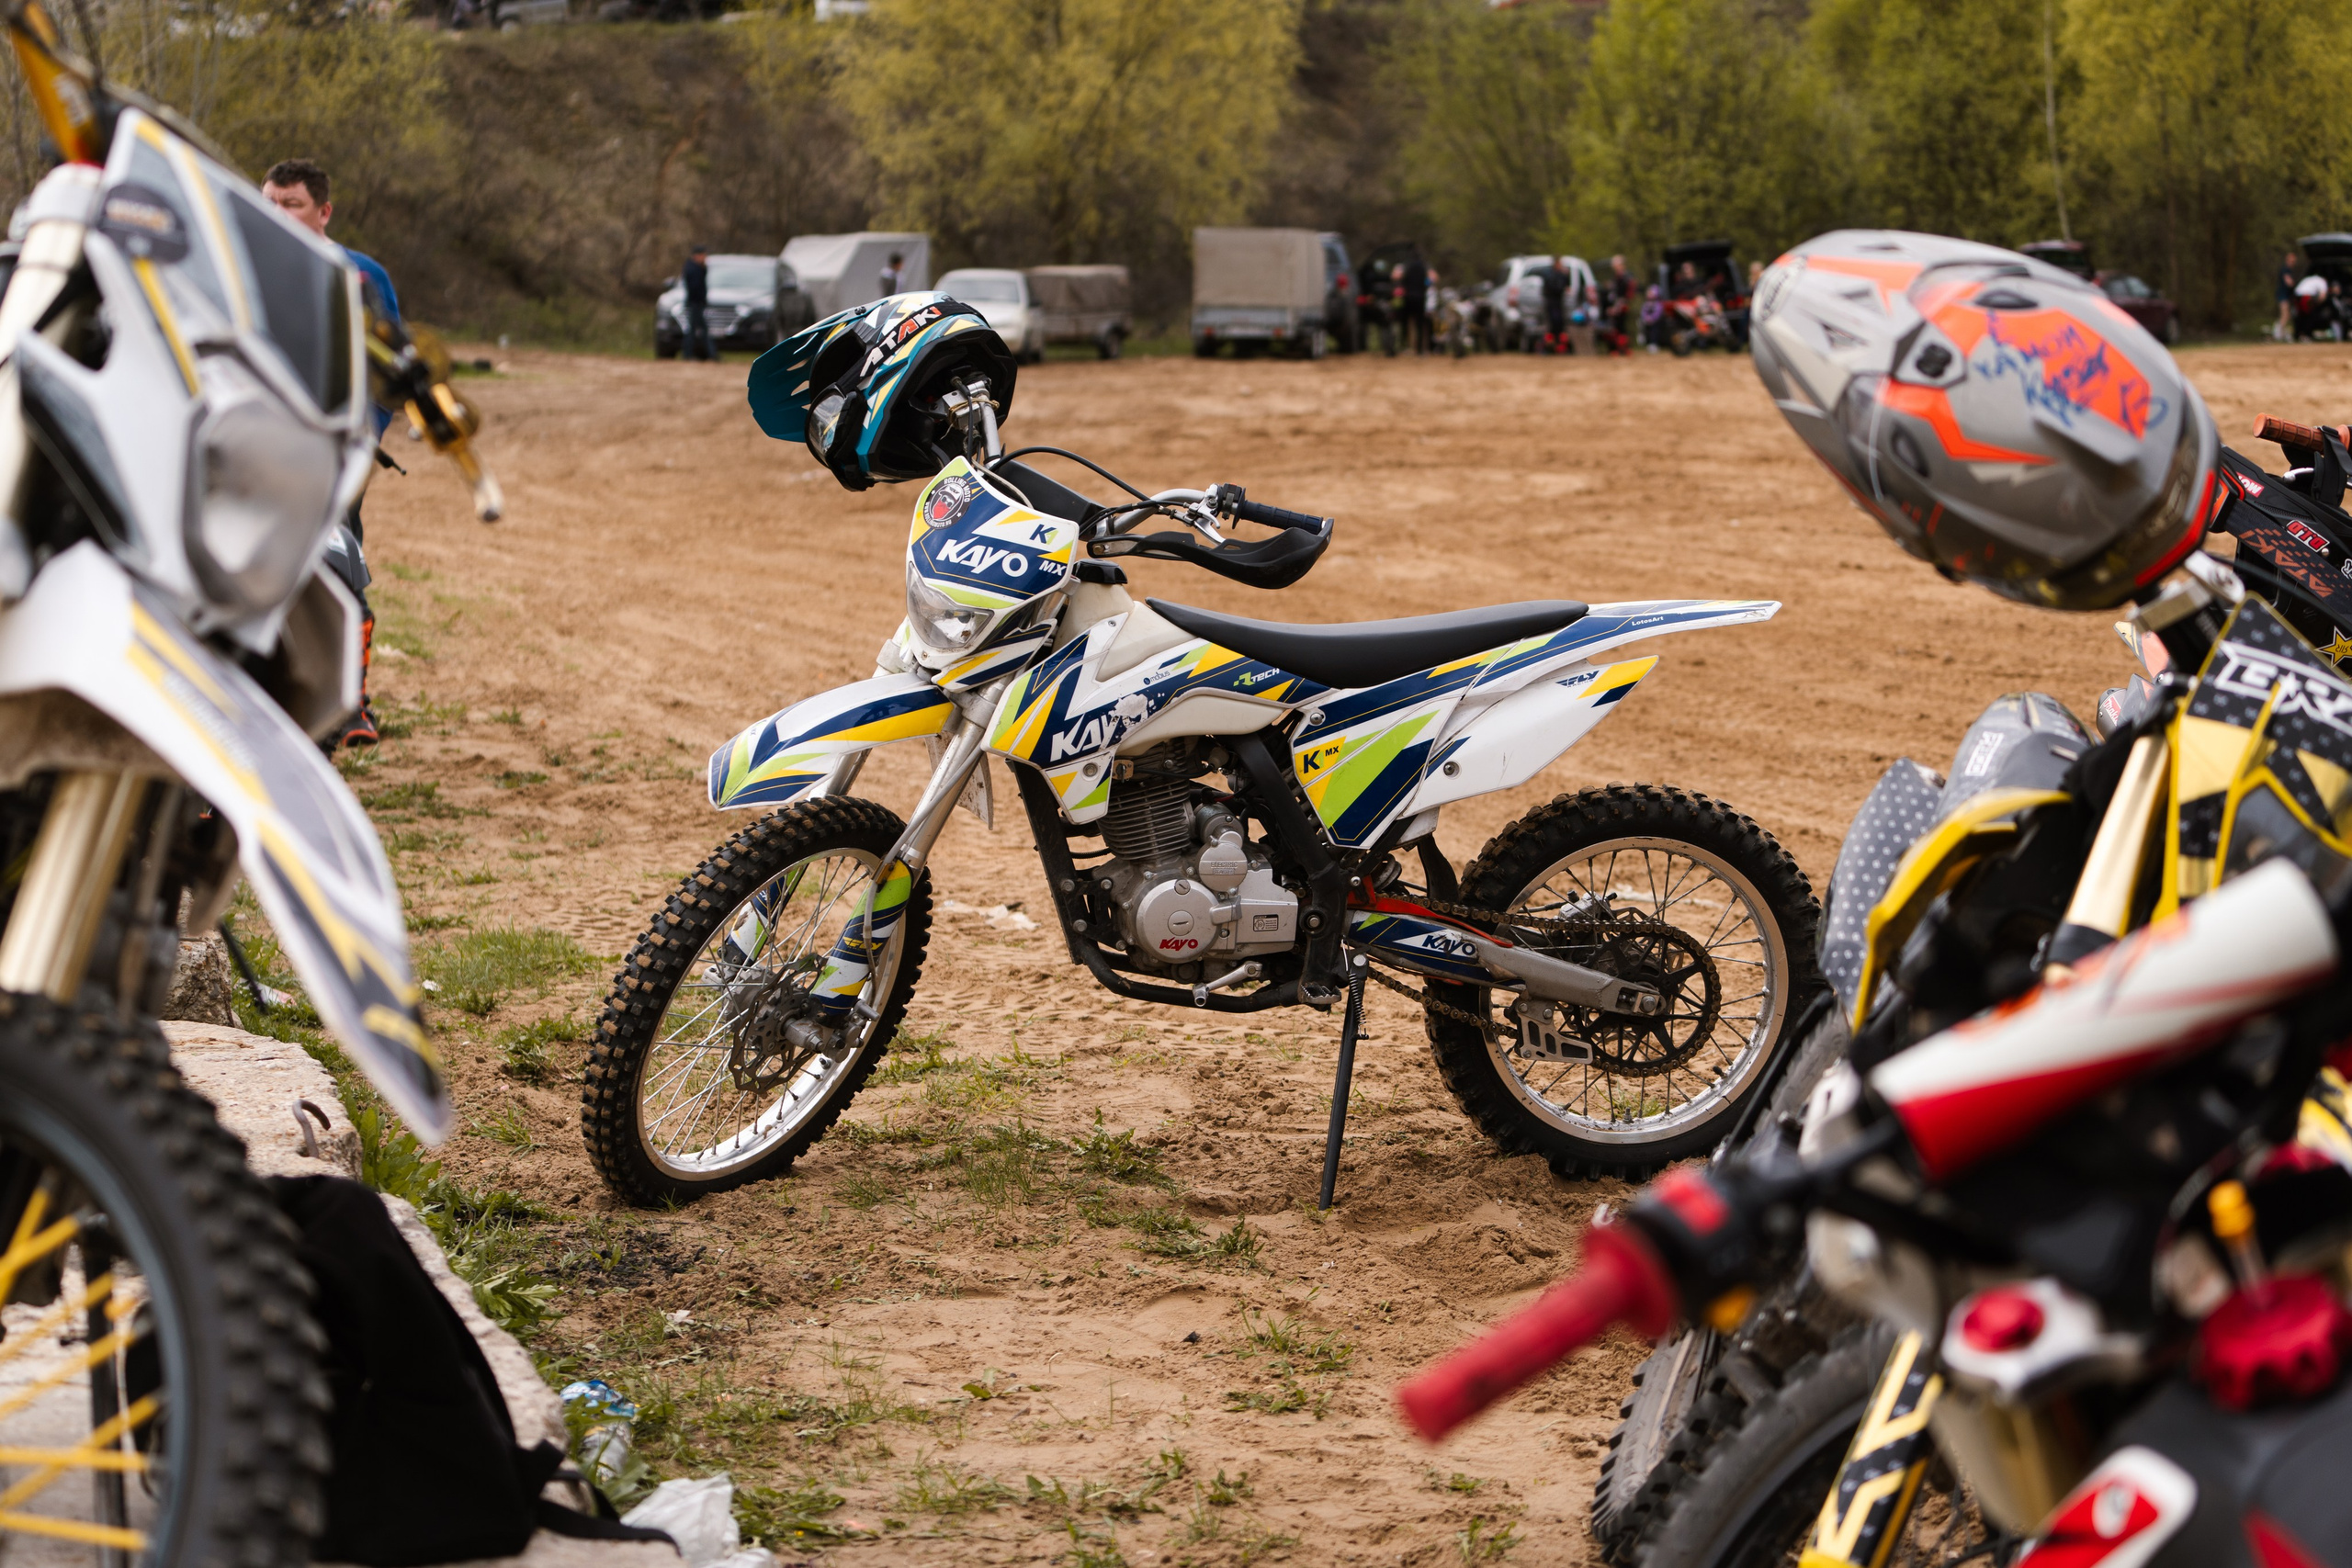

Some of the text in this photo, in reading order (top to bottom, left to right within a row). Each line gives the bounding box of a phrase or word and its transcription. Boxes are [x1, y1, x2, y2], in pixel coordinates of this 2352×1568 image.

[860, 306, 942, 377] ATAKI
[944, 477, 967, 487] ROLLING
[963, 484, 971, 502] MOTO
[935, 536, 1028, 577] KAYO
[2239, 529, 2334, 597] ATAKI
[1038, 560, 1067, 576] MX
[1631, 615, 1664, 626] LotosArt
[1556, 671, 1600, 686] FLY
[1325, 745, 1340, 757] MX
[1159, 936, 1199, 952] KAYO
[1421, 934, 1476, 955] KAYO
